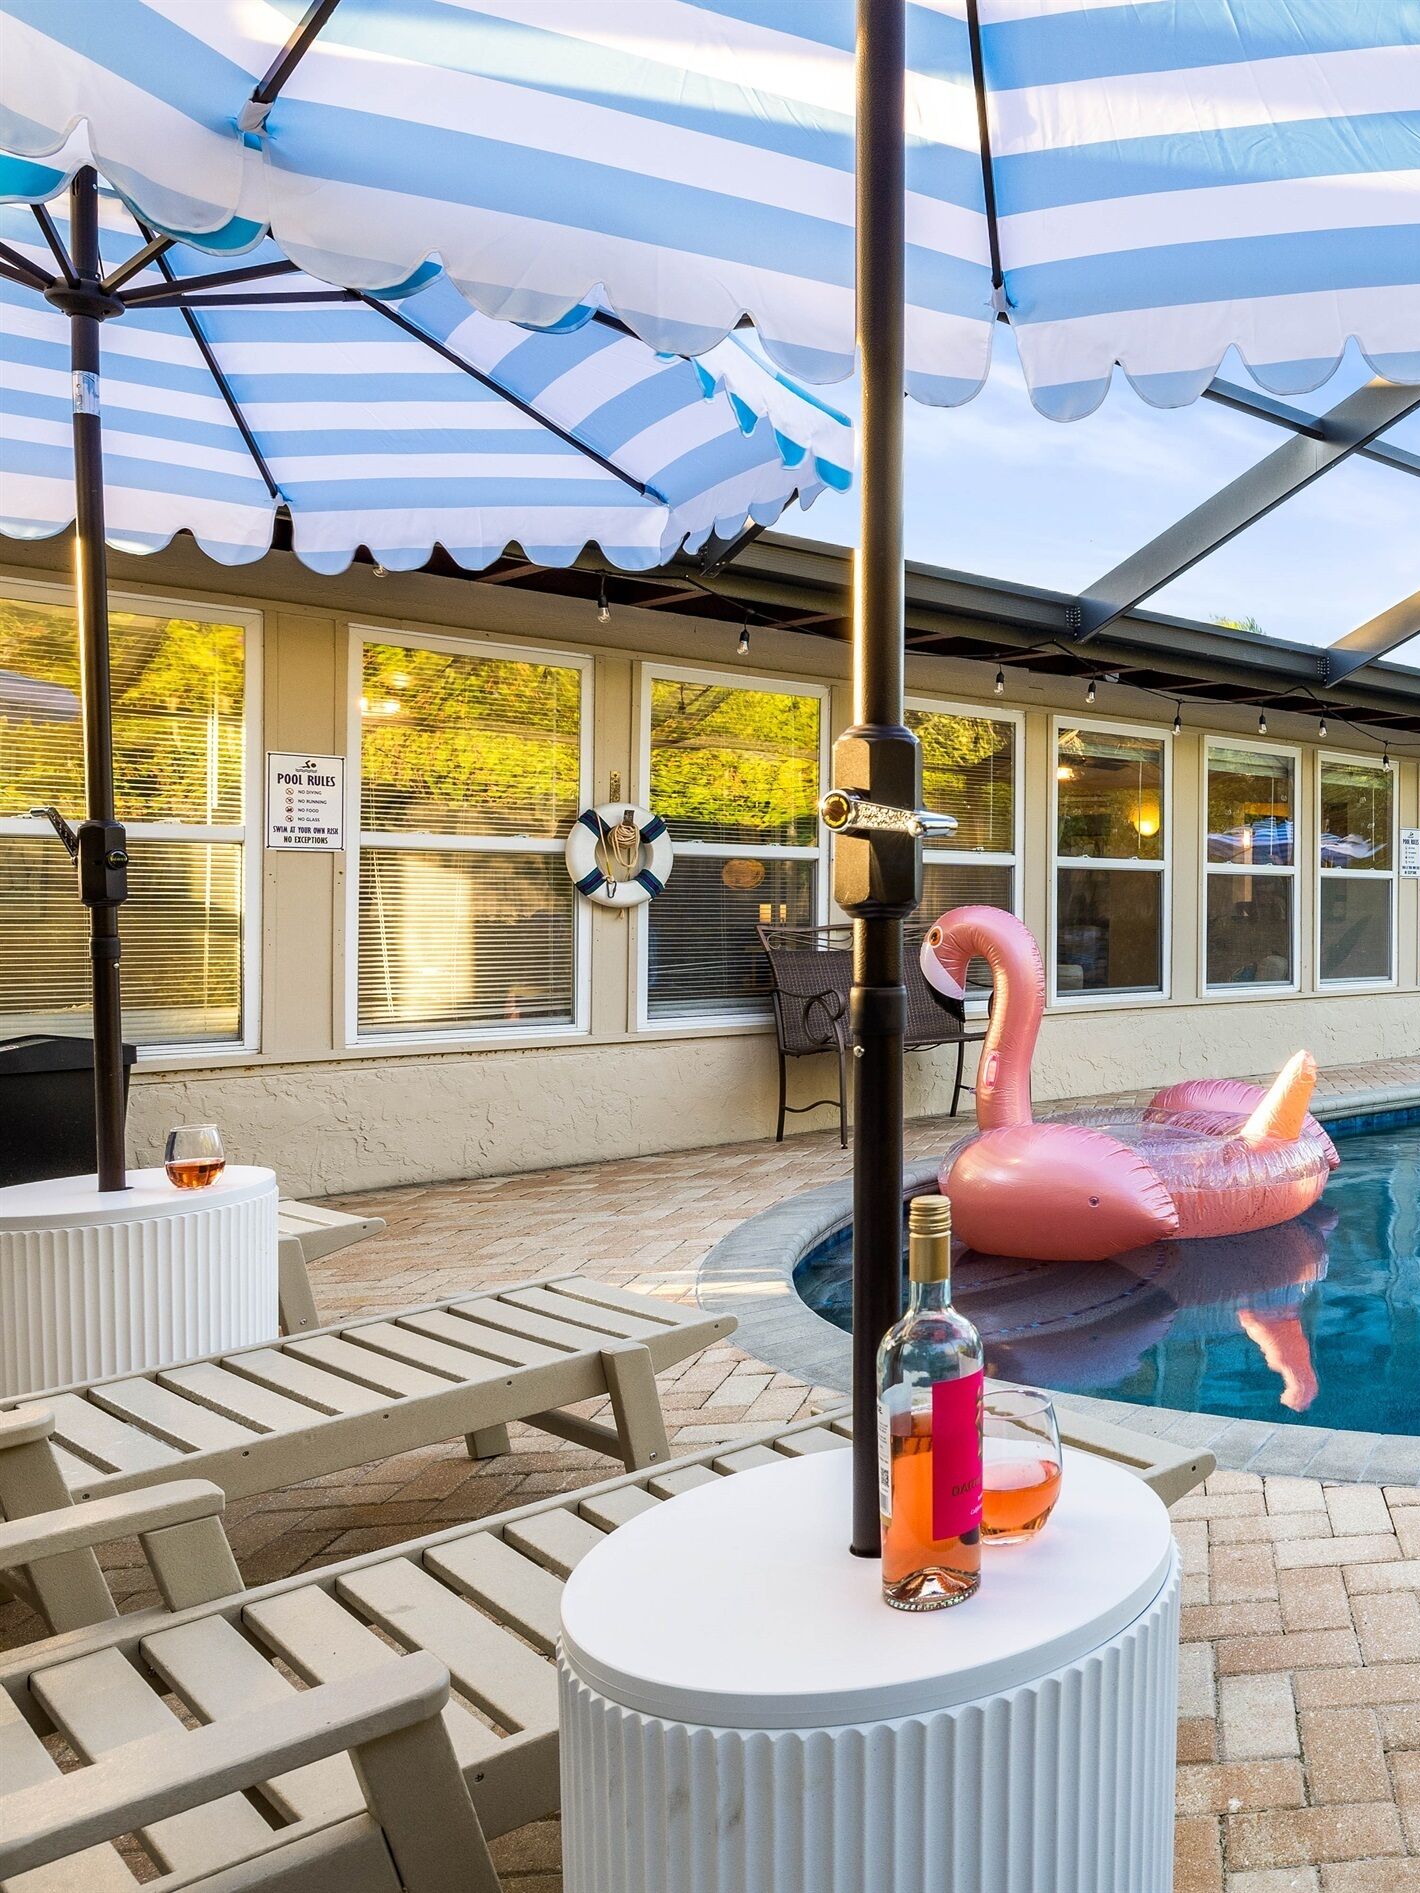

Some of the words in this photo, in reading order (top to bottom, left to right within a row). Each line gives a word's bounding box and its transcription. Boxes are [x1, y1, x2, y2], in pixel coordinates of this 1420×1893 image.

[277, 773, 303, 785] POOL
[307, 775, 336, 787] RULES
[295, 836, 328, 844] EXCEPTIONS
